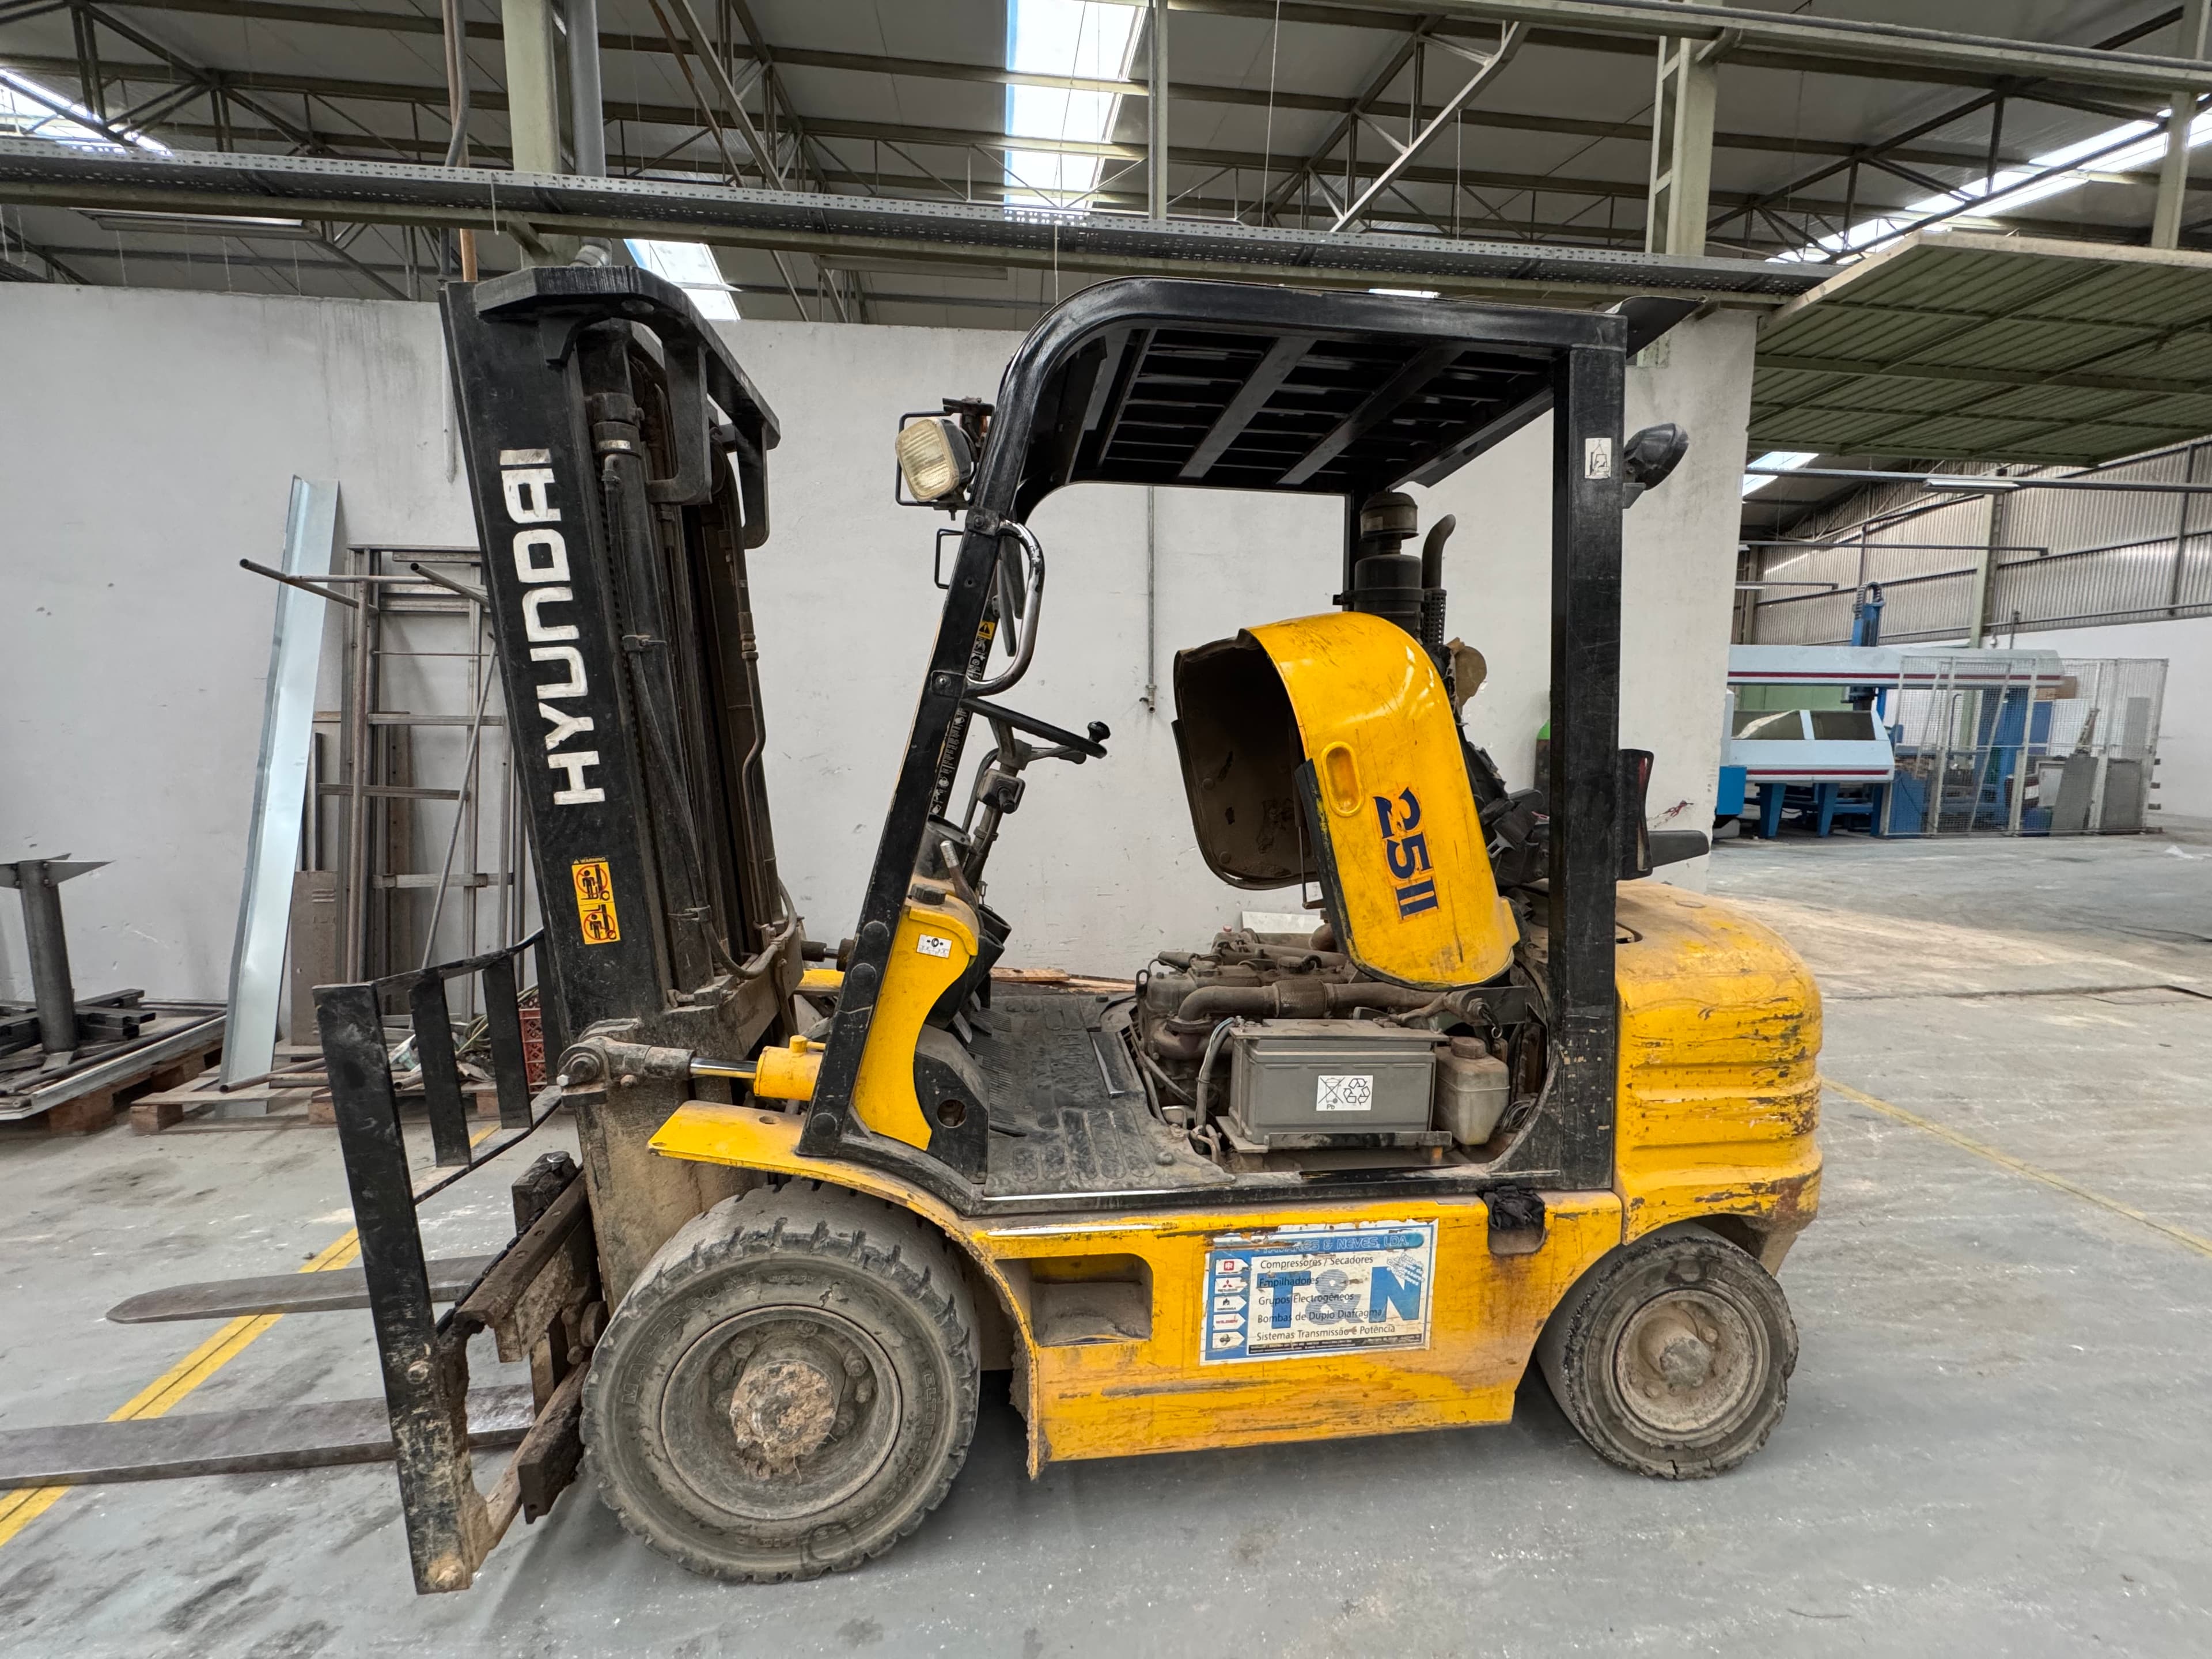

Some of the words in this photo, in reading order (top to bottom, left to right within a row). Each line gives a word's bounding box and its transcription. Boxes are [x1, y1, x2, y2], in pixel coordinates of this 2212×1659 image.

[500, 448, 605, 805] HYUNDAI
[1323, 1239, 1333, 1250] &
[1383, 1236, 1410, 1248] LDA.
[1260, 1258, 1322, 1270] Compressores
[1330, 1256, 1374, 1266] Secadores
[1259, 1275, 1319, 1288] Empilhadores
[1259, 1297, 1290, 1306] Grupos
[1257, 1313, 1292, 1324] Bombas
[1295, 1312, 1306, 1321] de
[1309, 1310, 1335, 1321] Duplo
[1338, 1309, 1382, 1319] Diafragma
[1256, 1332, 1295, 1341] Sistemas
[1297, 1328, 1349, 1339] Transmissão
[1359, 1325, 1395, 1334] Potência
